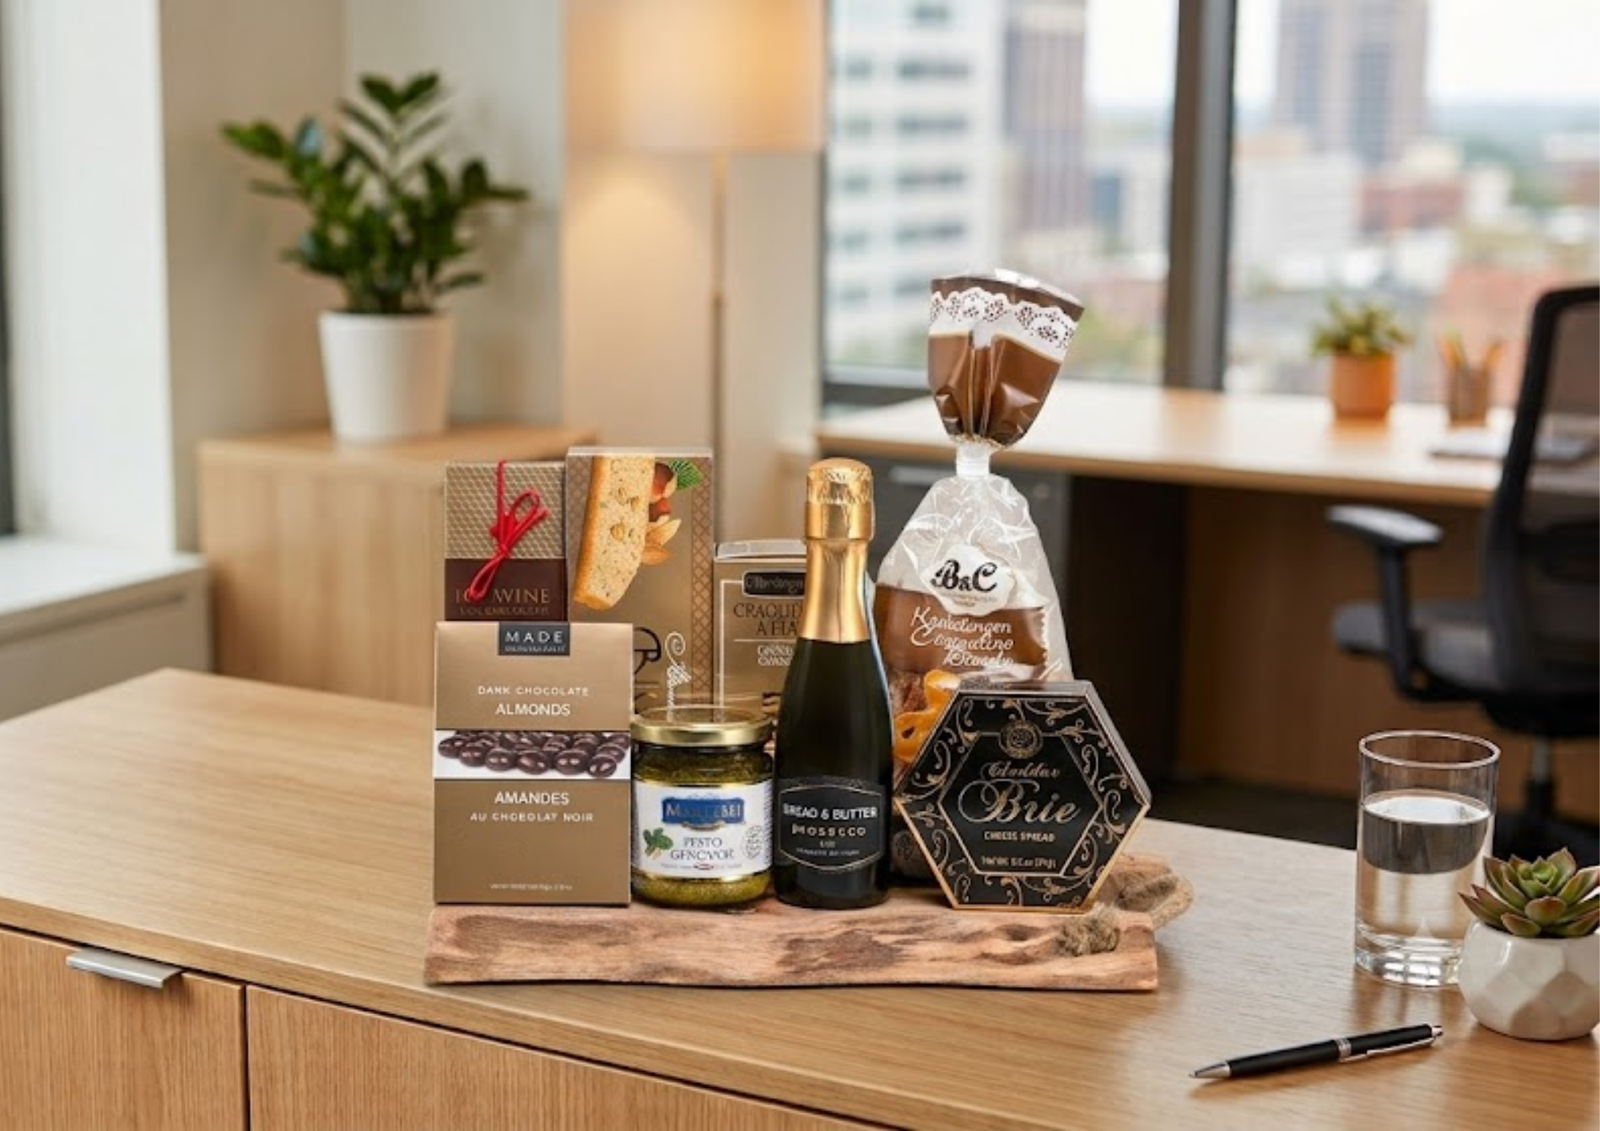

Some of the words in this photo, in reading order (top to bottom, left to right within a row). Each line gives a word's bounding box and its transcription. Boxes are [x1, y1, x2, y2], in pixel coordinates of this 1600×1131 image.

[930, 559, 998, 592] B&C
[493, 588, 550, 603] WINE
[505, 630, 563, 643] MADE
[516, 686, 589, 697] CHOCOLATE
[495, 703, 571, 716] ALMONDS
[494, 791, 570, 806] AMANDES
[957, 779, 1080, 824] Brie
[470, 812, 488, 822] AU
[563, 812, 594, 822] NOIR
[832, 806, 878, 820] BUTTER
